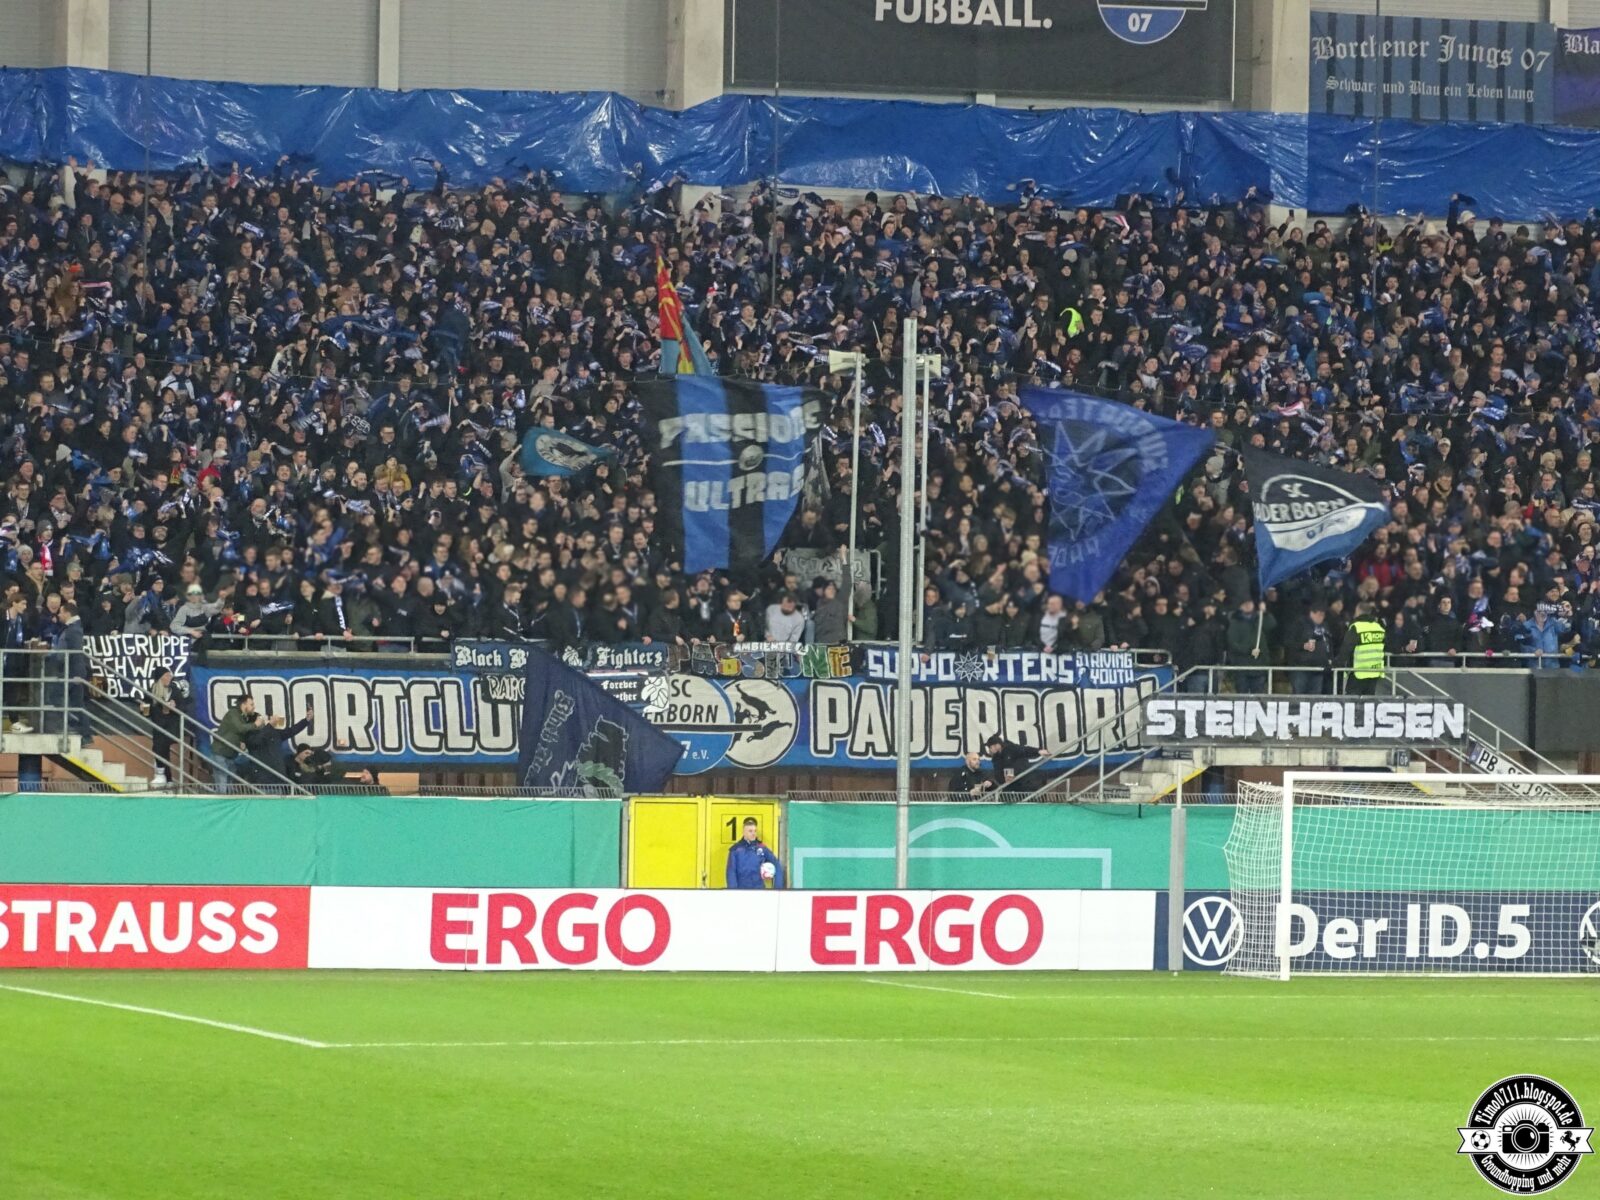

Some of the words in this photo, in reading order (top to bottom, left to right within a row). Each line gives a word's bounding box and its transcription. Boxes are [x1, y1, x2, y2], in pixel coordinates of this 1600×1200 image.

[1128, 13, 1153, 33] 07
[1437, 35, 1512, 69] Jungs
[1520, 49, 1550, 73] 07
[1383, 80, 1404, 94] und
[1409, 80, 1440, 96] Blau
[1444, 83, 1462, 97] ein
[1466, 82, 1503, 99] Leben
[1508, 85, 1534, 102] lang
[82, 633, 190, 656] BLUTGRUPPE
[90, 656, 188, 678] SCHWARZ
[455, 645, 503, 667] Black
[597, 646, 663, 669] Fighters
[1090, 668, 1134, 684] YOUTH
[107, 679, 155, 700] BLA
[671, 679, 692, 698] SC
[208, 675, 524, 757] SPORTCLU
[1146, 700, 1465, 740] STEINHAUSEN
[680, 741, 692, 760] 7
[1478, 750, 1498, 772] PB
[726, 816, 737, 841] 1
[430, 892, 672, 967] ERGO
[809, 894, 1044, 966] ERGO
[1276, 903, 1388, 958] Der
[1405, 903, 1531, 960] ID.5
